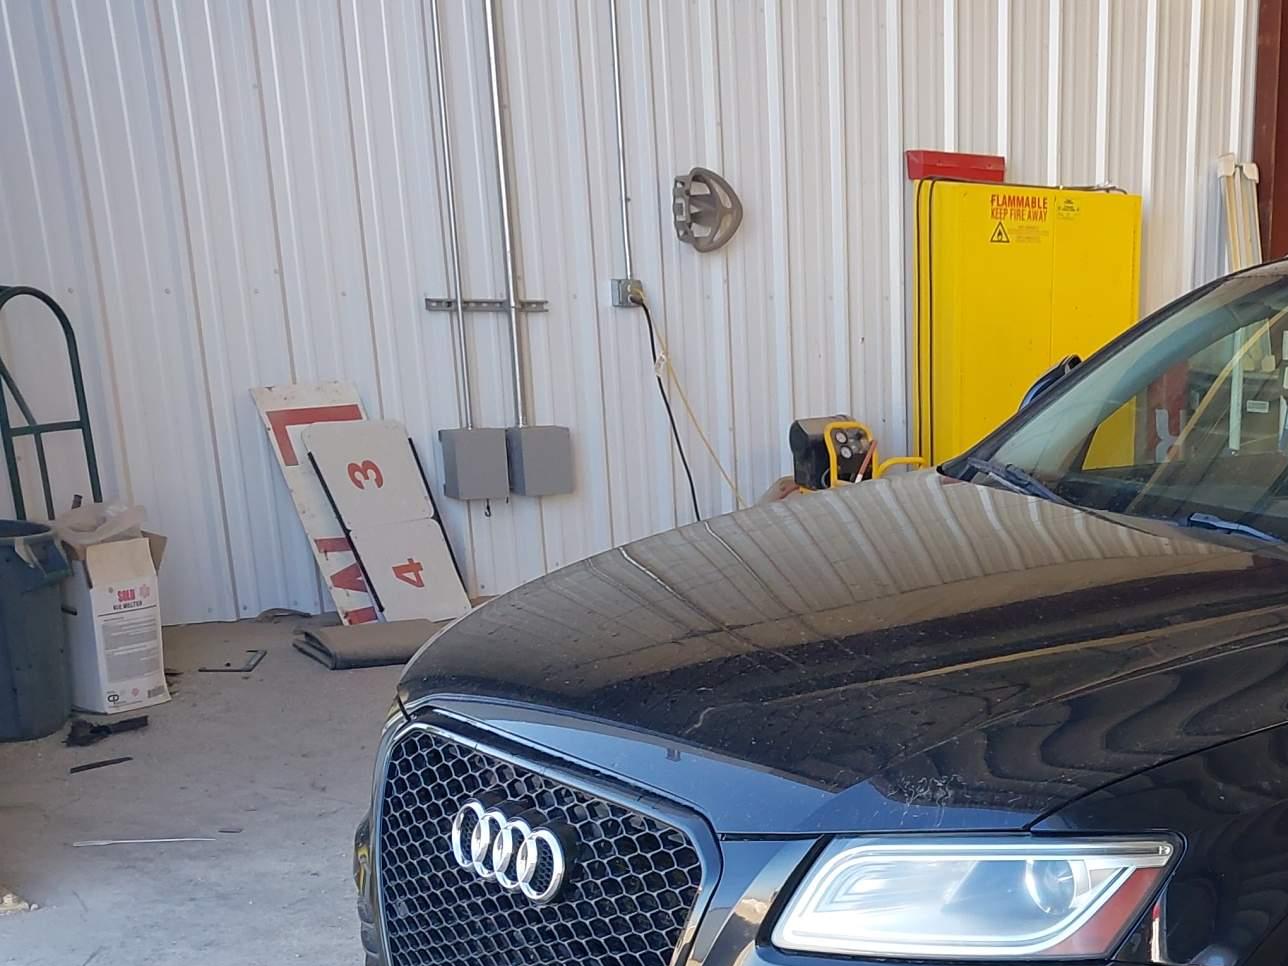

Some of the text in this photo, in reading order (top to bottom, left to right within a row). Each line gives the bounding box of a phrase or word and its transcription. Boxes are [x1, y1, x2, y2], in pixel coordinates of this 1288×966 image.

[991, 194, 1047, 209] FLAMMABLE
[991, 207, 1008, 220] KEEP
[1009, 208, 1025, 221] FIRE
[1027, 209, 1047, 222] AWAY
[347, 459, 384, 490] 3
[391, 558, 425, 588] 4
